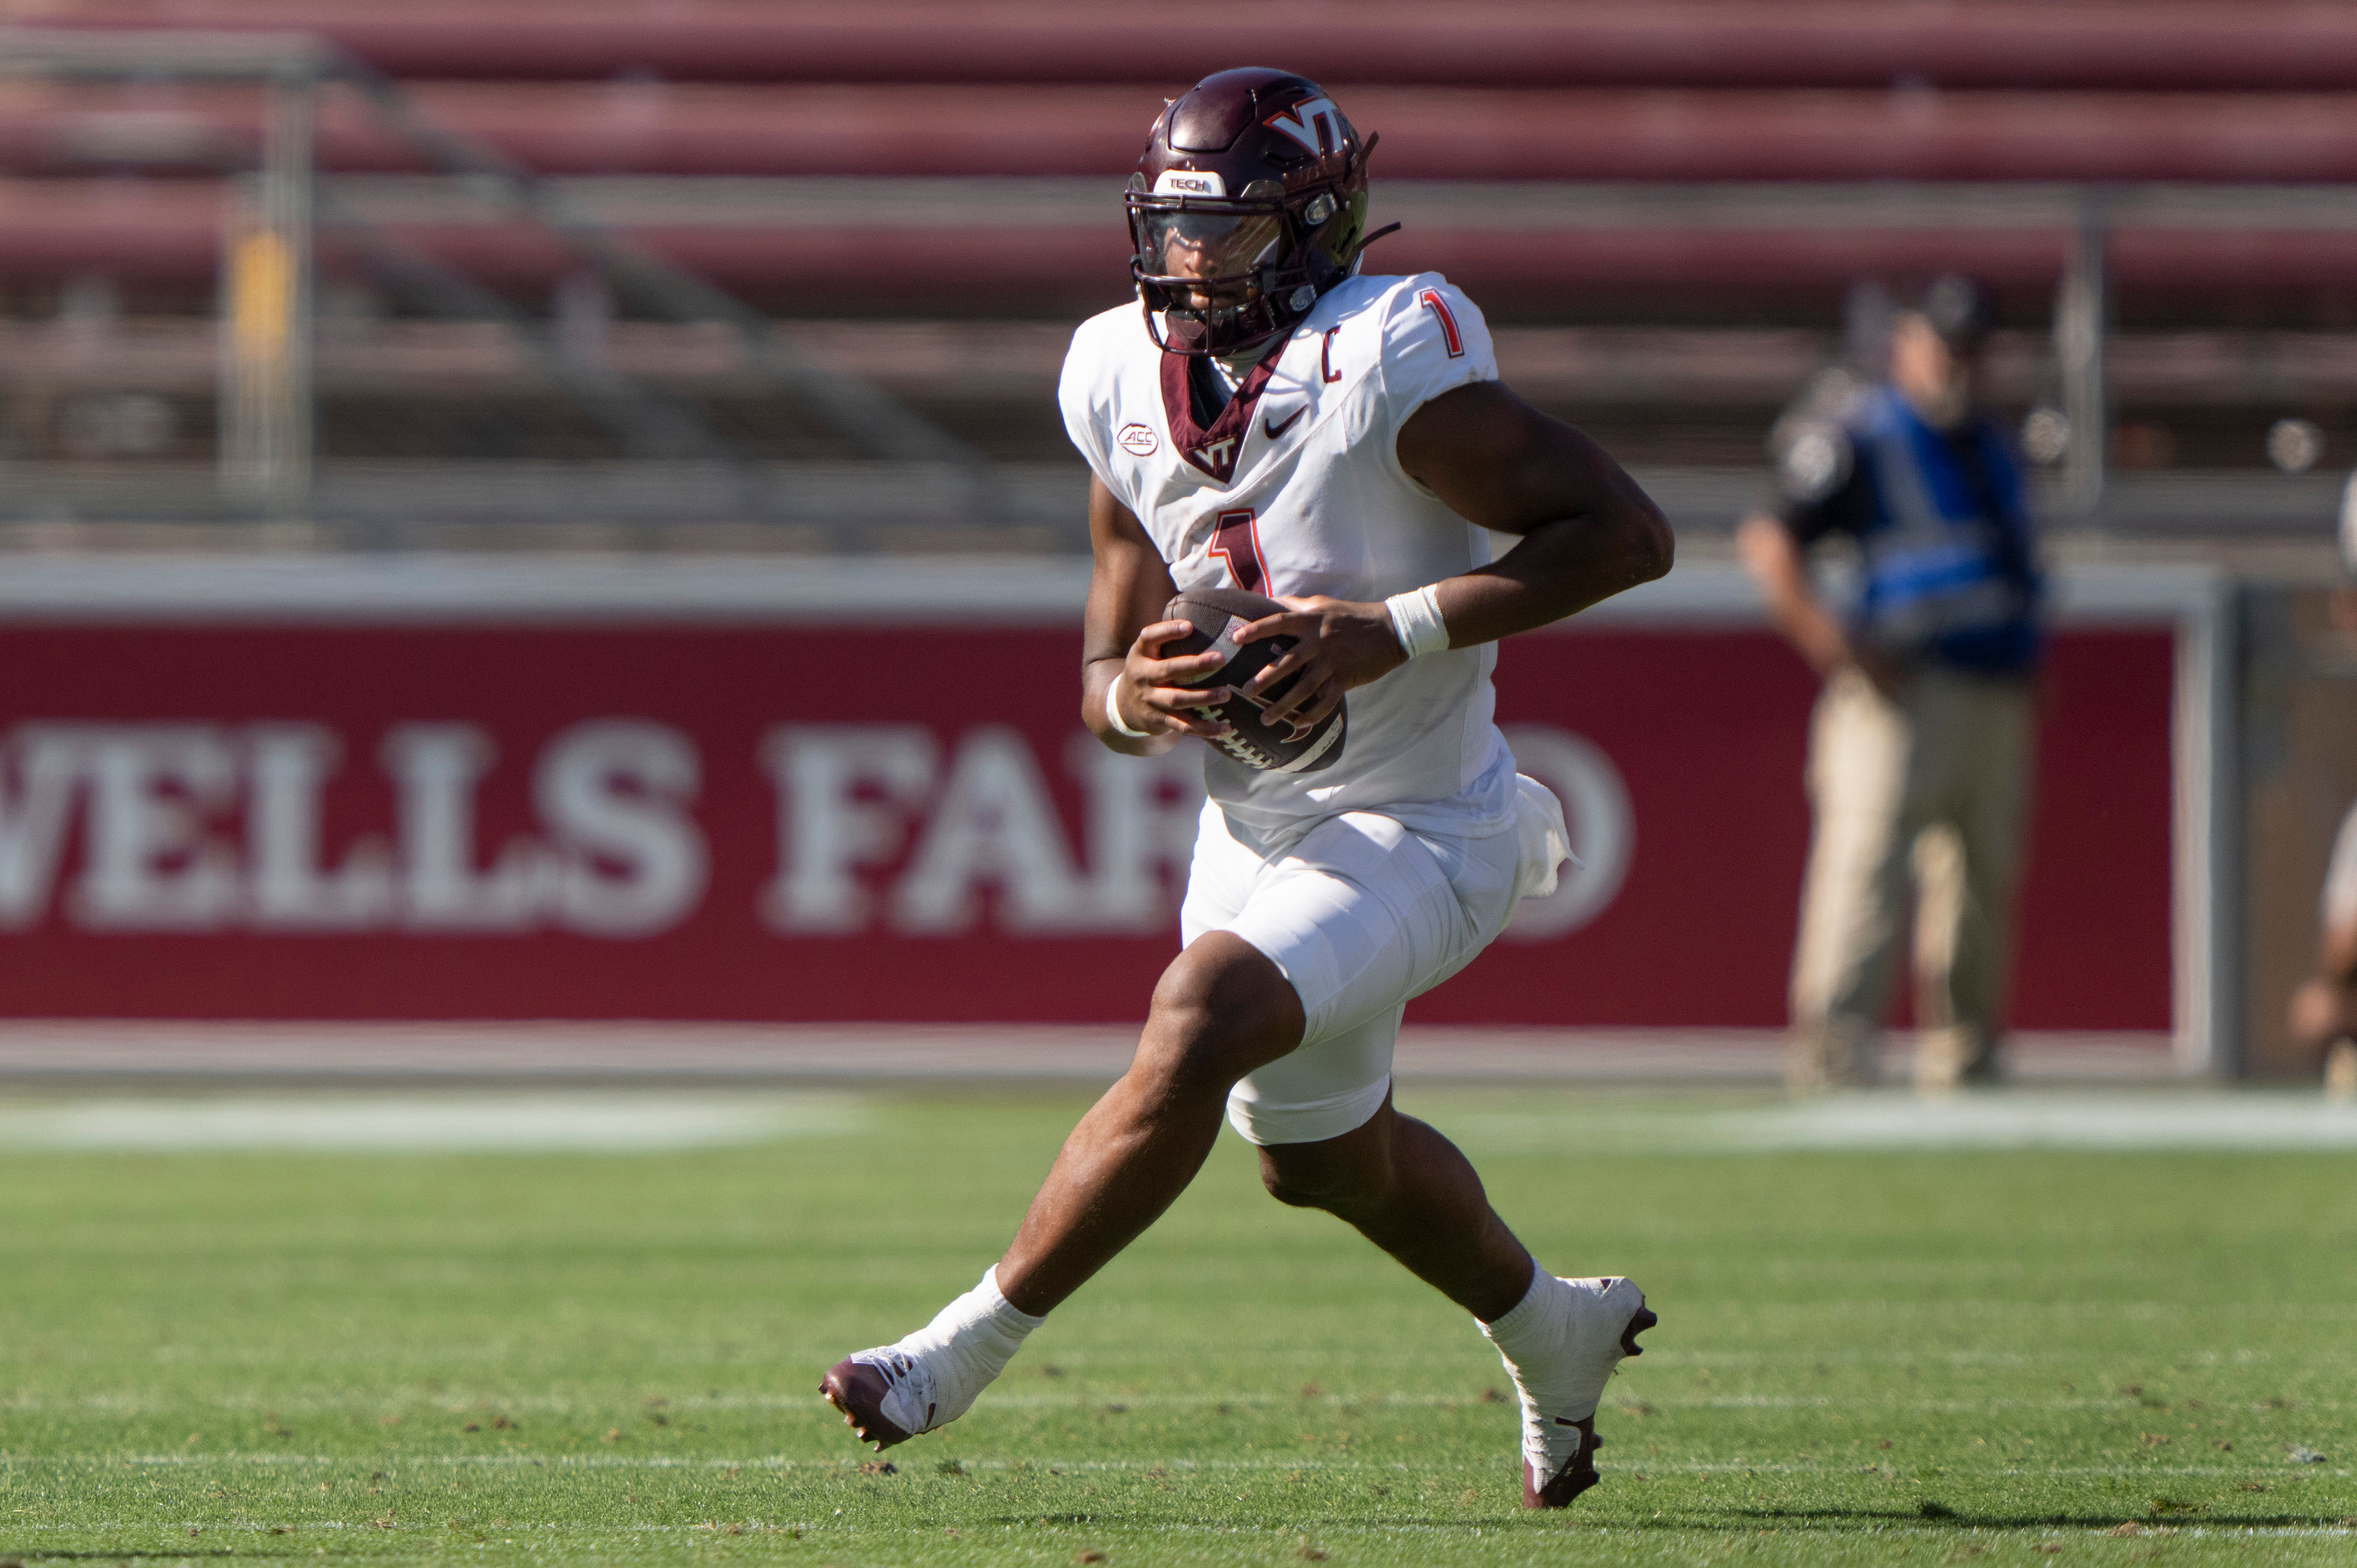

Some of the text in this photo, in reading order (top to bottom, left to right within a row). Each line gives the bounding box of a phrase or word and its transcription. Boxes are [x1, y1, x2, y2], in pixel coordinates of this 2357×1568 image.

[1263, 96, 1345, 166] VT
[1169, 178, 1205, 192] TECH
[1419, 287, 1465, 358] 1
[1321, 324, 1342, 384] C
[1124, 431, 1153, 443] ACC
[1193, 435, 1236, 470] VT
[1207, 507, 1274, 599] 1
